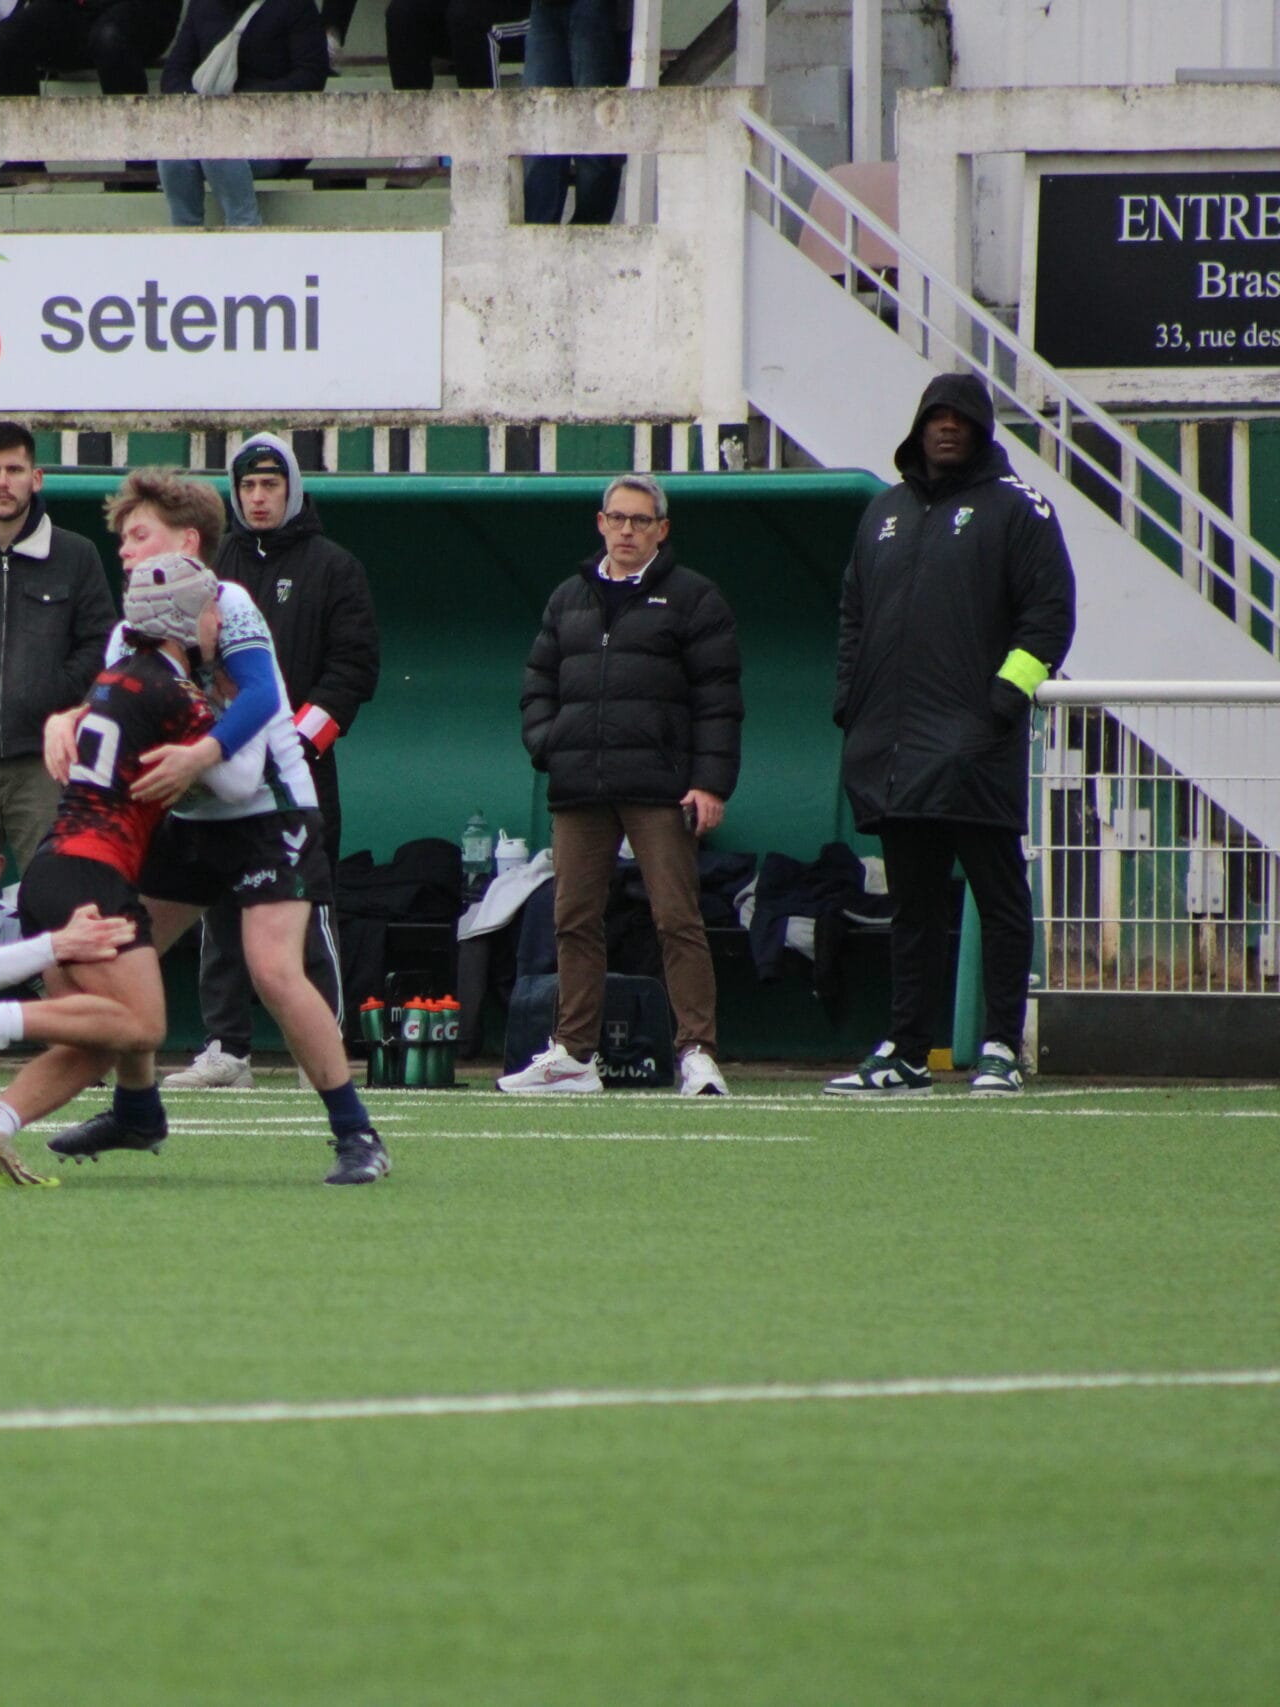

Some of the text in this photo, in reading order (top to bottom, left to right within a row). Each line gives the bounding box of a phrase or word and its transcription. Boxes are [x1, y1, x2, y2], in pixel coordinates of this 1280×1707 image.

[1118, 193, 1280, 241] ENTRE
[1198, 261, 1280, 298] Bras
[40, 275, 319, 354] setemi
[1156, 322, 1280, 352] 33, rue des
